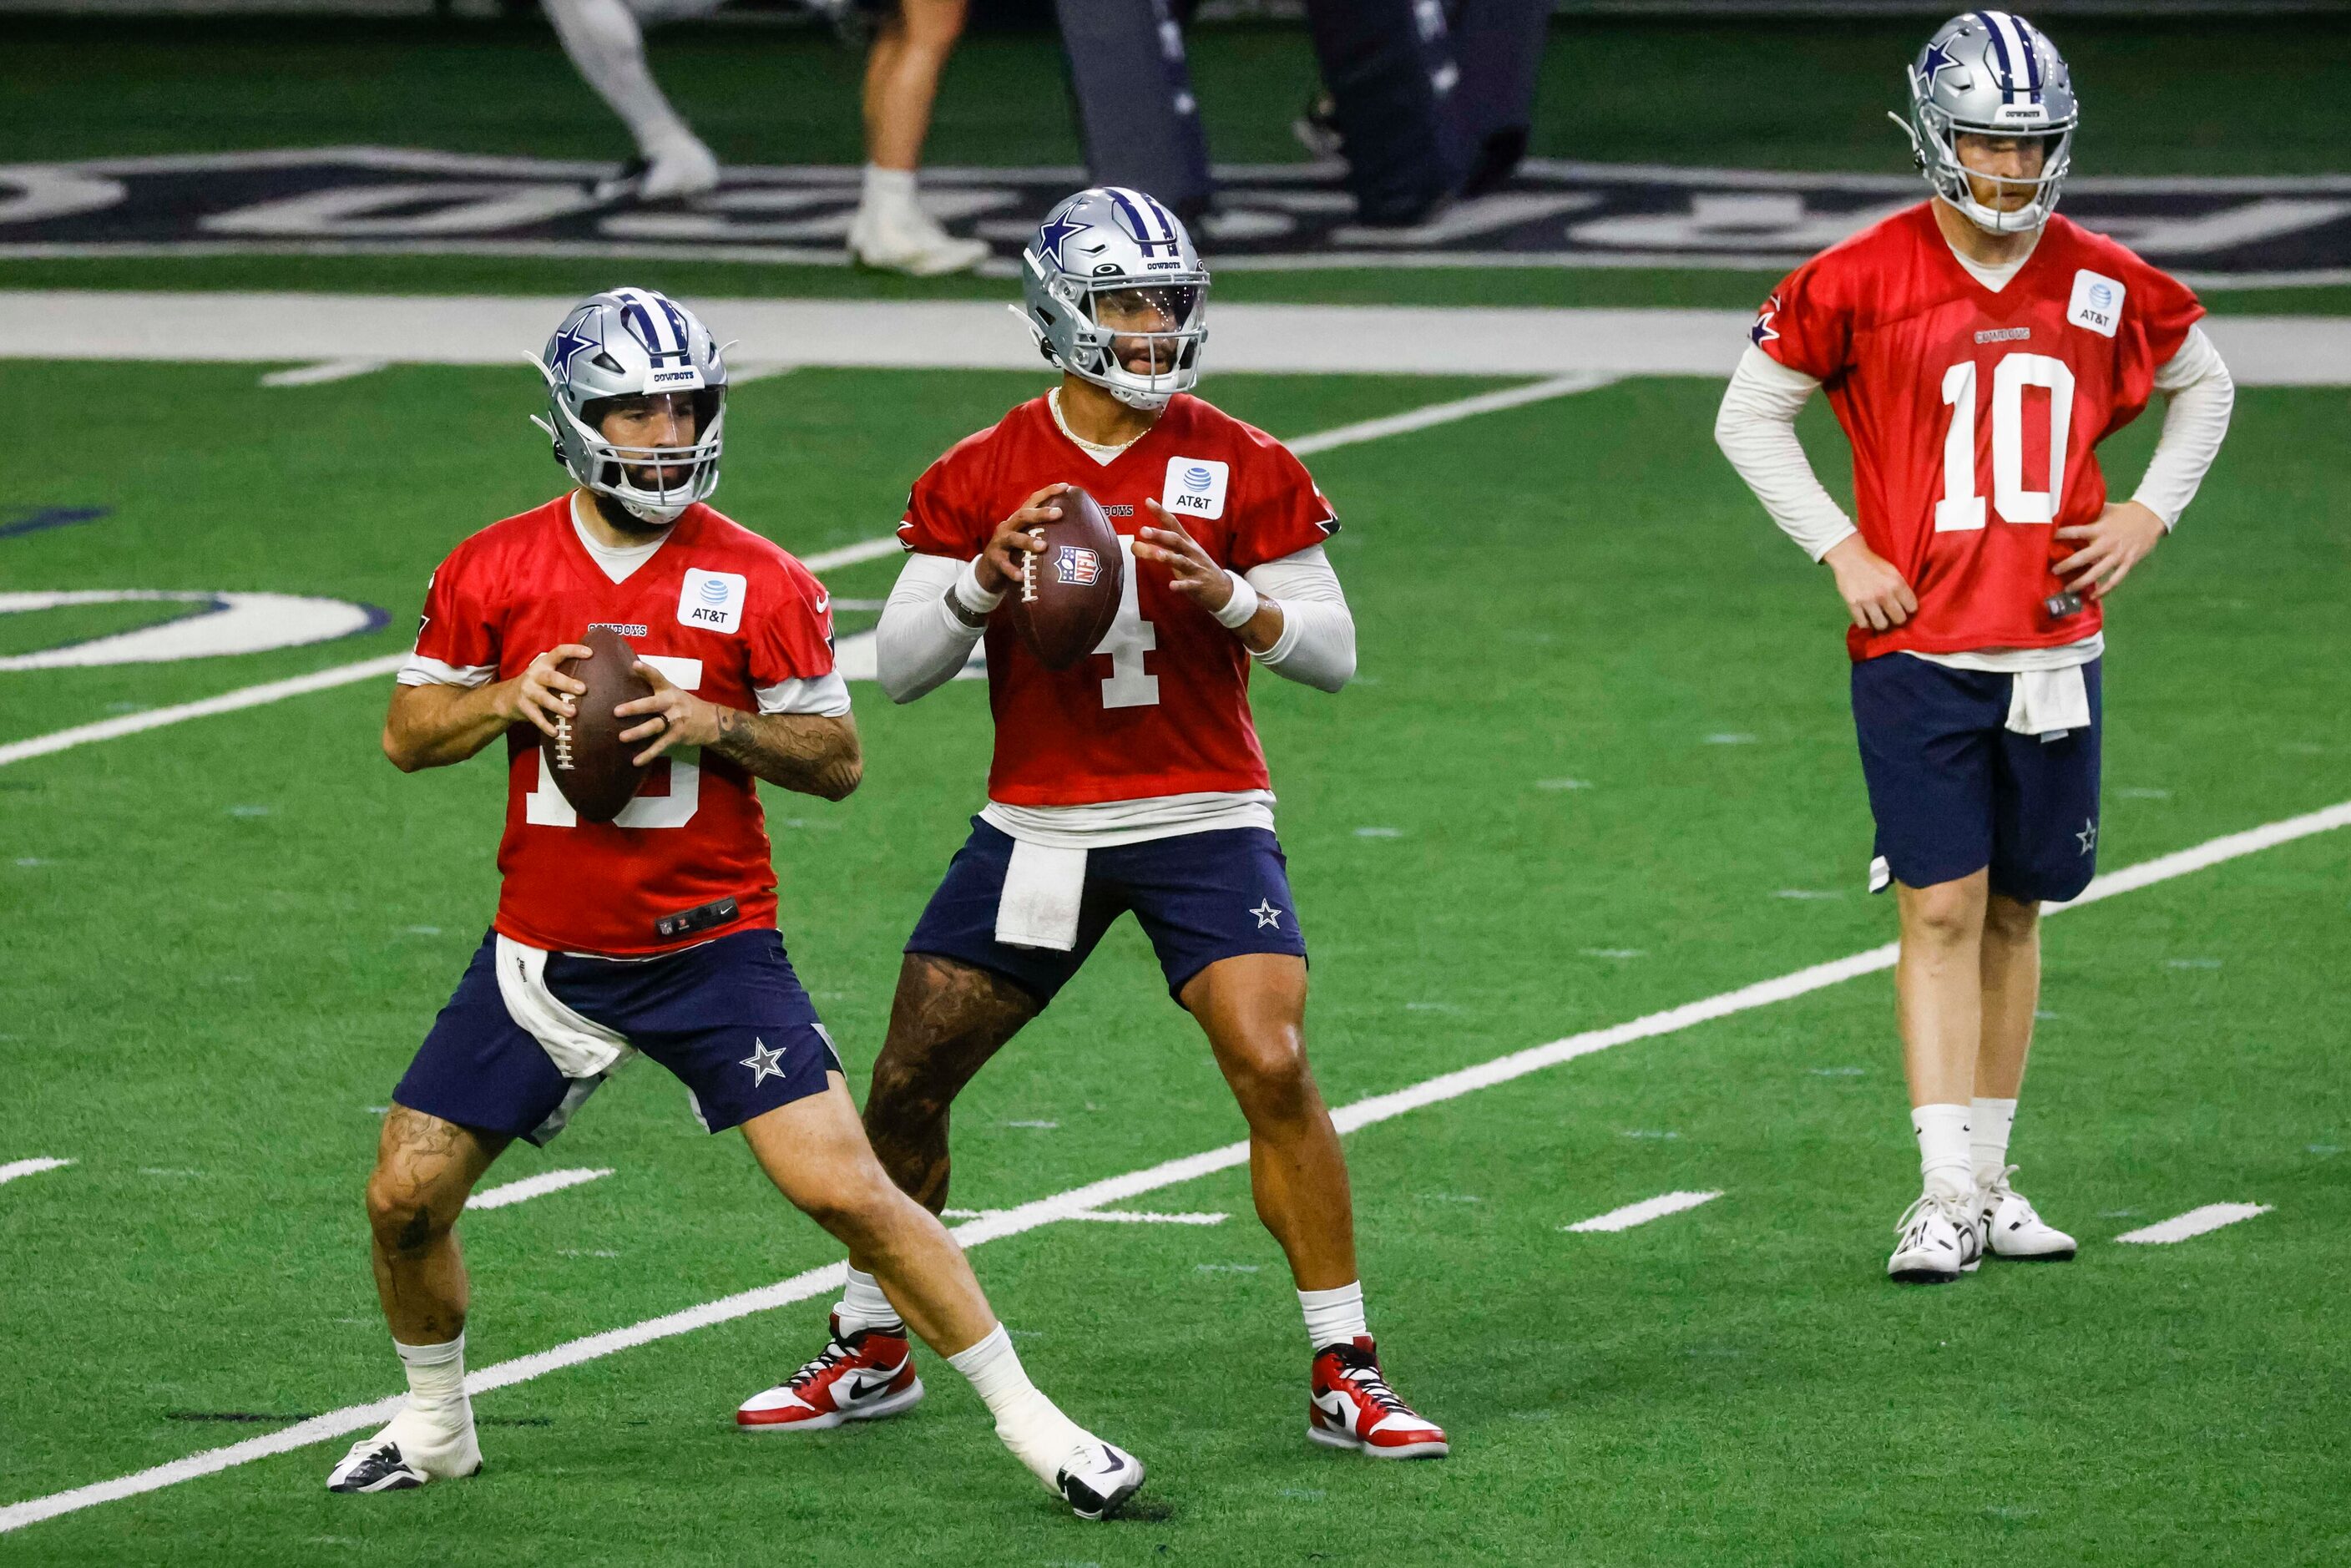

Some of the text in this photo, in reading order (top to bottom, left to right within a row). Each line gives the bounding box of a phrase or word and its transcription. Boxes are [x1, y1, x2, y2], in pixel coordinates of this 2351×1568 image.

[1147, 261, 1181, 270] COWBOYS
[2080, 308, 2111, 328] AT&T
[654, 371, 695, 382] COWBOYS
[1934, 352, 2075, 533] 10
[1176, 494, 1212, 510] AT&T
[1100, 505, 1134, 517] BOYS
[1075, 553, 1097, 582] NFL
[691, 607, 729, 624] AT&T
[588, 623, 647, 636] CBOYS
